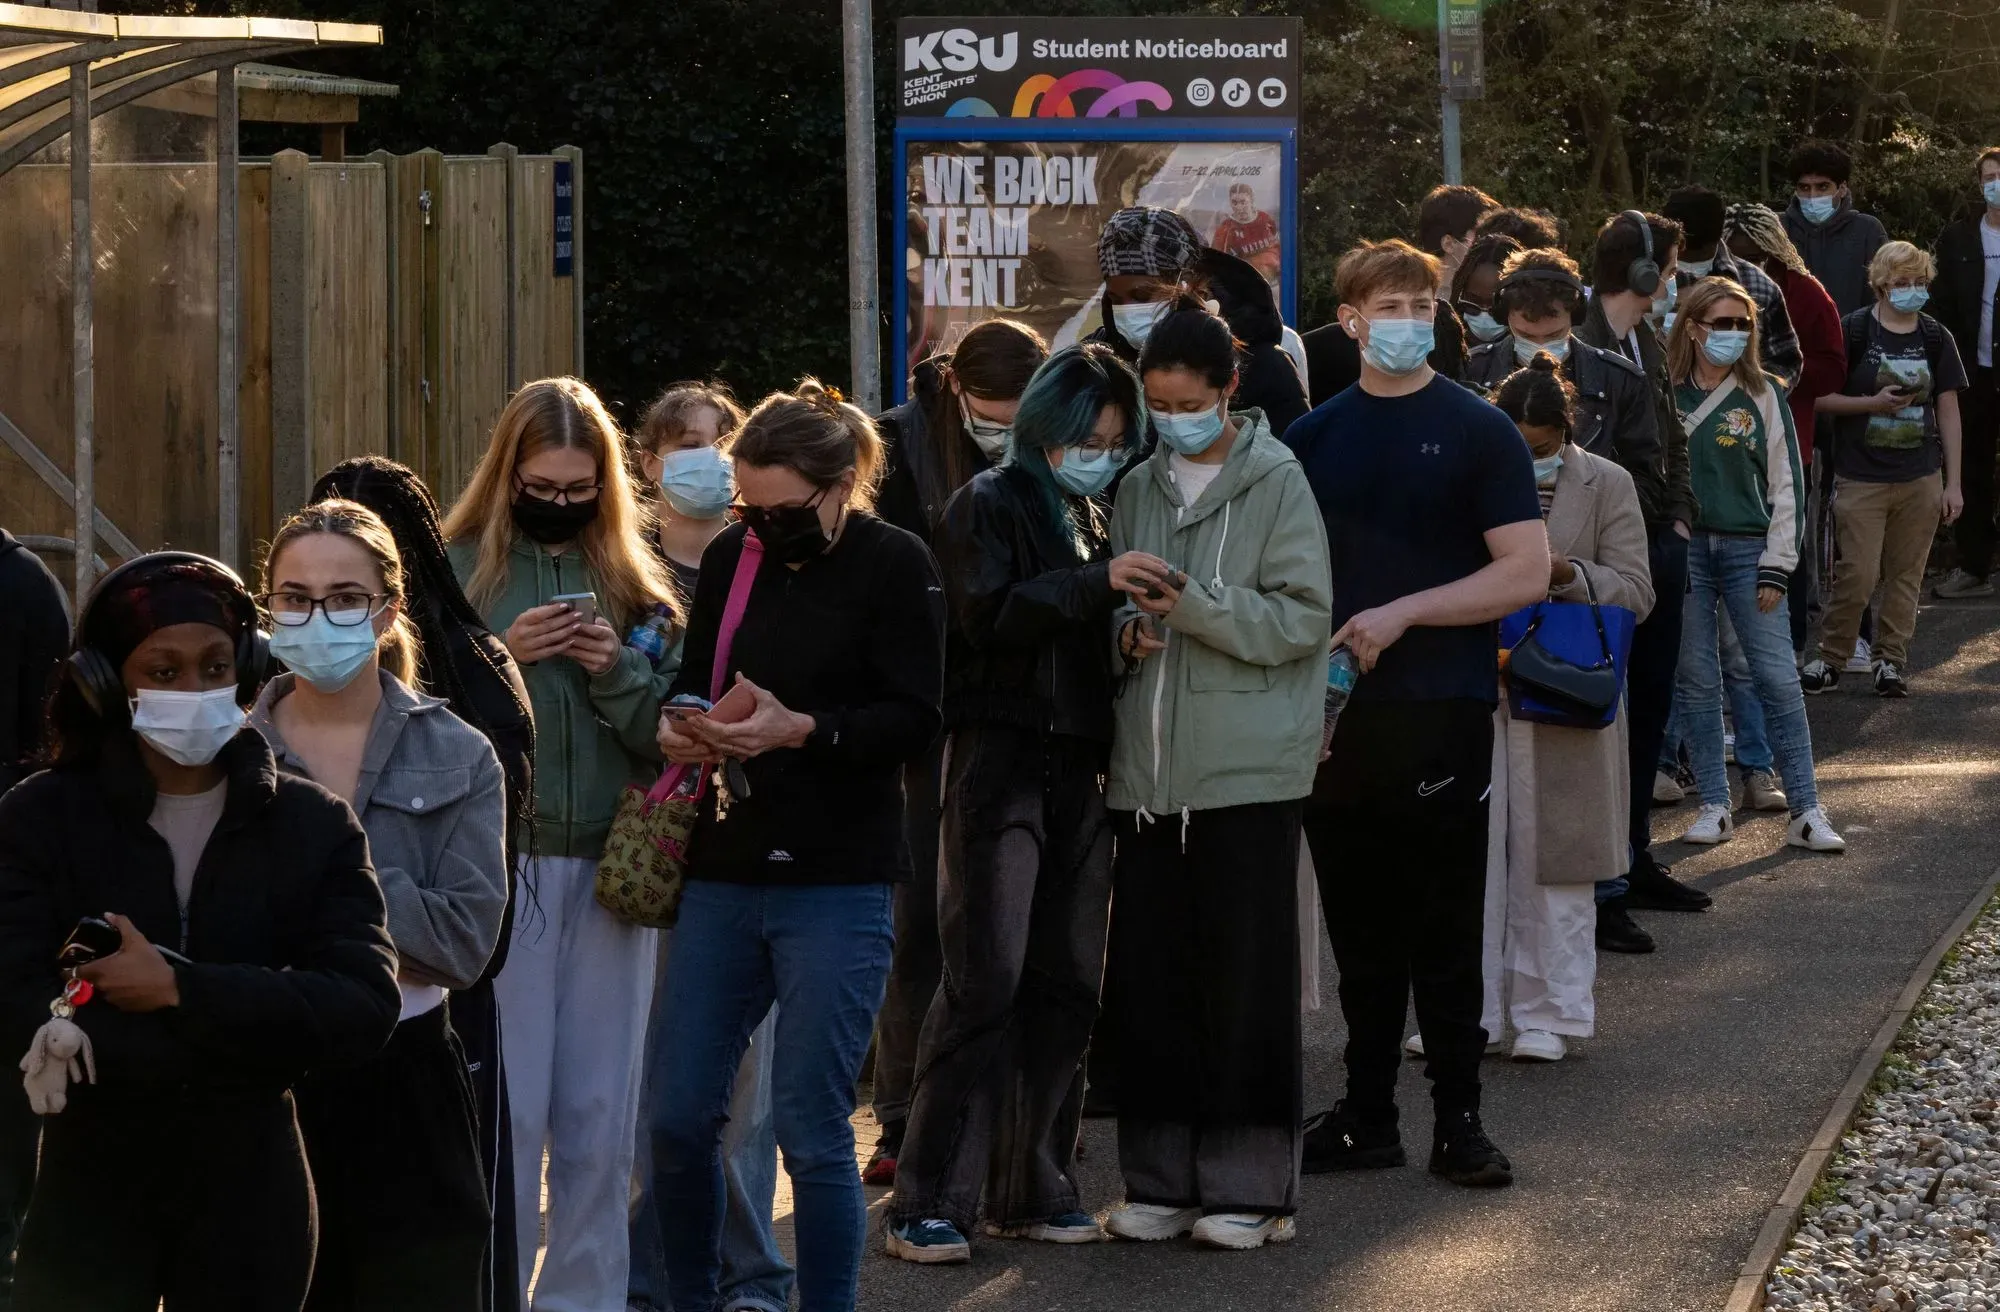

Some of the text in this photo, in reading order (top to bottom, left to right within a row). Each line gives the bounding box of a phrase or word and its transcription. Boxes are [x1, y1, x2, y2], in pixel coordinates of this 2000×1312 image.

[904, 28, 1018, 73] KSU
[1032, 38, 1288, 59] Student Noticeboard
[904, 72, 943, 89] KENT
[904, 90, 947, 107] UNION
[922, 156, 1099, 205] WE BACK
[1210, 166, 1238, 177] APRIL
[922, 207, 1029, 256] TEAM
[923, 258, 1022, 307] KENT
